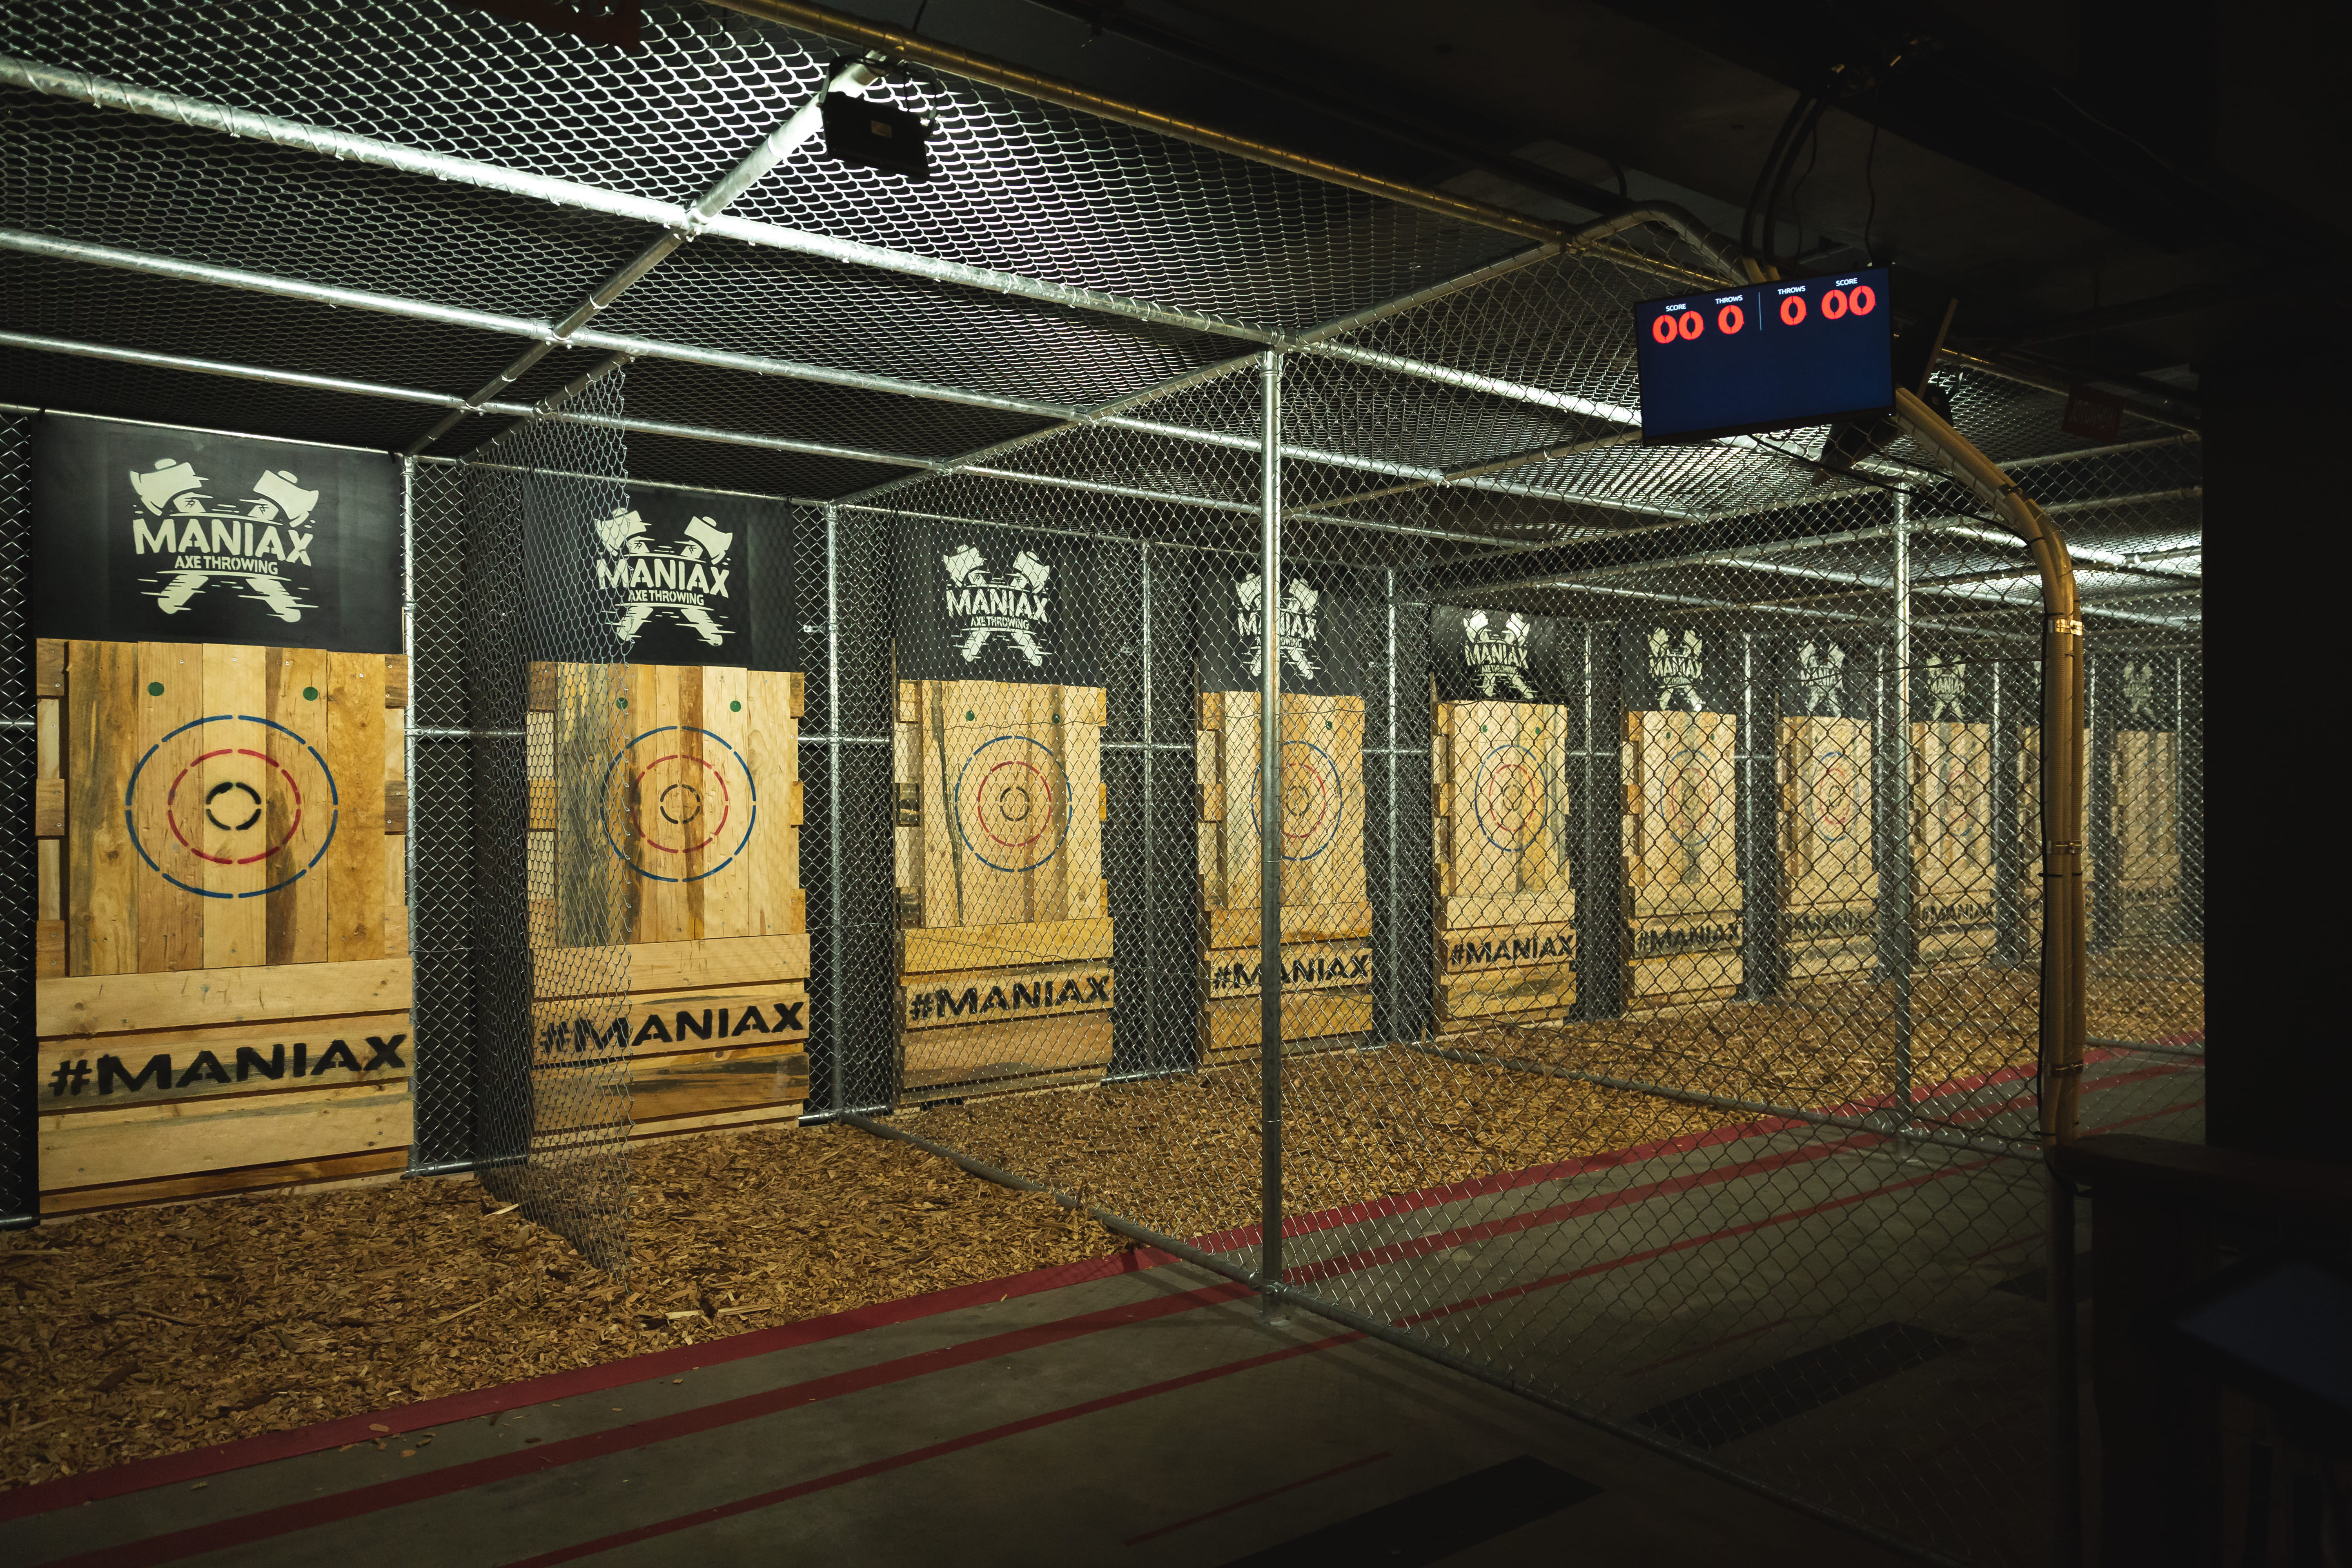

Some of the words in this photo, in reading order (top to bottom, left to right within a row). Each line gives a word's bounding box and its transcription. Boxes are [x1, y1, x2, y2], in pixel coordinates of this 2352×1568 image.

[1777, 285, 1806, 295] THROWS
[1836, 278, 1857, 286] SCORE
[1666, 303, 1686, 312] SCORE
[1715, 295, 1743, 304] THROWS
[1780, 296, 1807, 325] 0
[1822, 285, 1876, 320] 00
[1653, 311, 1704, 344] 00
[1718, 305, 1744, 334] 0
[133, 518, 313, 567] MANIAX
[175, 556, 201, 570] AXE
[203, 556, 278, 575] THROWING
[596, 559, 729, 598] MANIAX
[628, 590, 647, 601] AXE
[648, 590, 704, 606] THROWING
[946, 588, 1048, 623] MANIAX
[971, 616, 986, 627] AXE
[987, 616, 1029, 630] THROWING
[1238, 612, 1316, 641] MIAX
[1465, 644, 1529, 669] MANIAX
[1451, 935, 1574, 964] #MANIAX
[909, 976, 1110, 1020] #MANIAX
[541, 1001, 804, 1054] #MANIAX
[48, 1033, 407, 1097] #MANIAX
